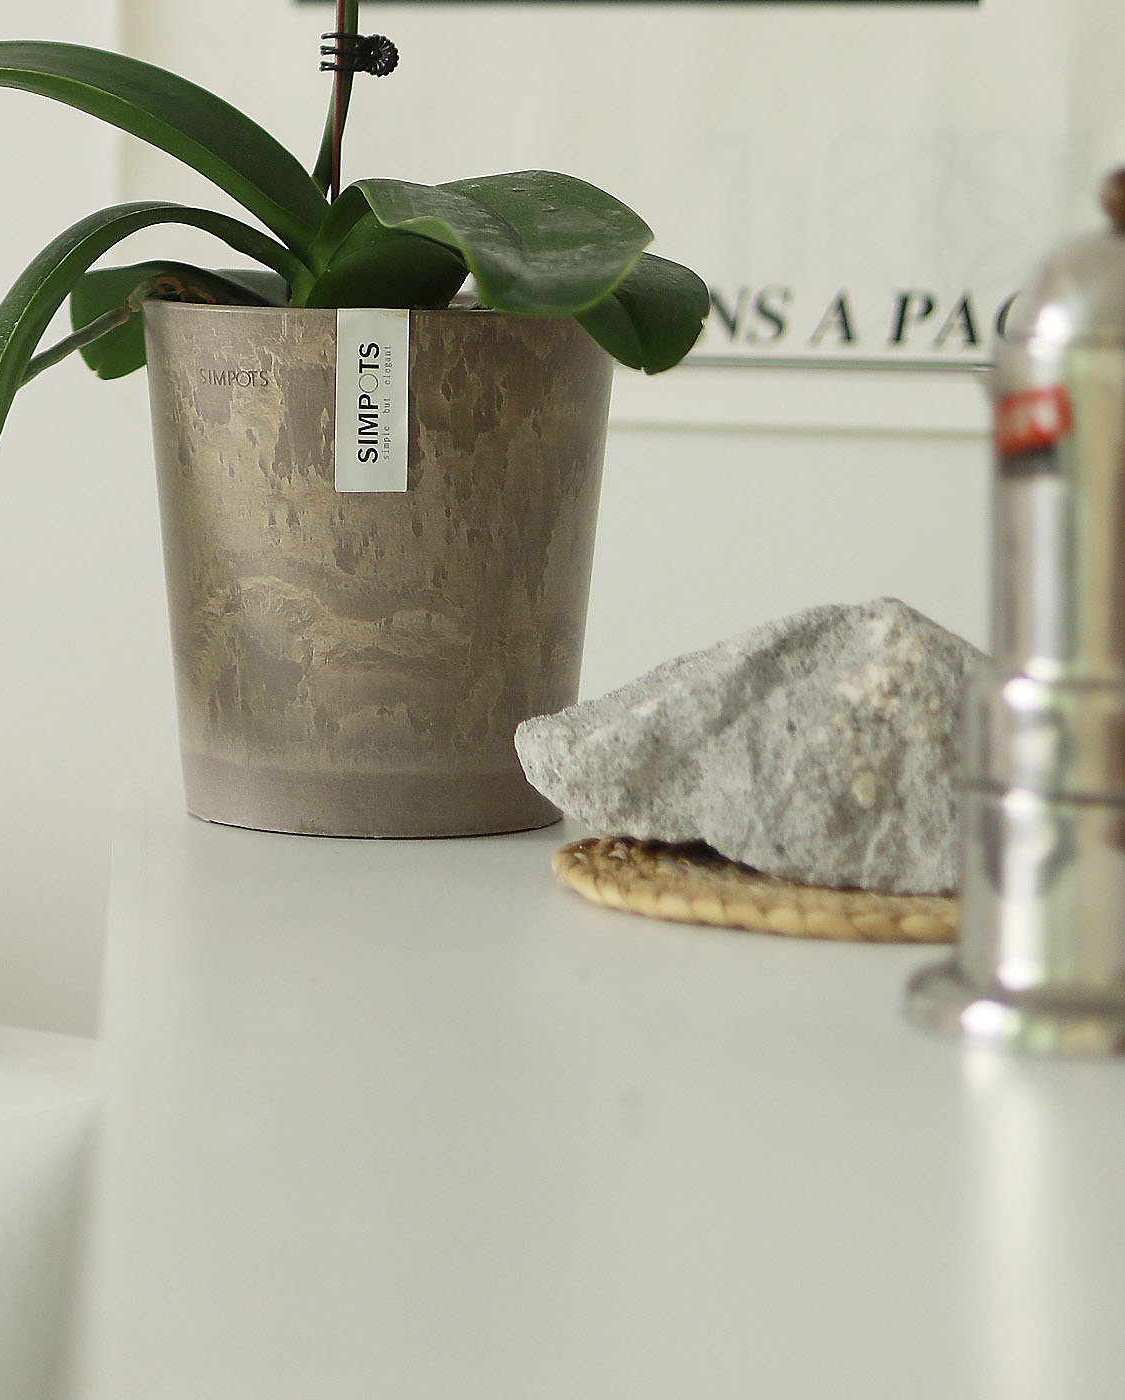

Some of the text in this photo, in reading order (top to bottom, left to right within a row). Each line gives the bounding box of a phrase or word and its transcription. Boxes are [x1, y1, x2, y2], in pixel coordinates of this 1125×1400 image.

[811, 289, 857, 345] A
[199, 367, 269, 387] SIMPOTS
[357, 342, 380, 463] SIMPOTS
[382, 397, 391, 414] but
[381, 426, 392, 460] simple
